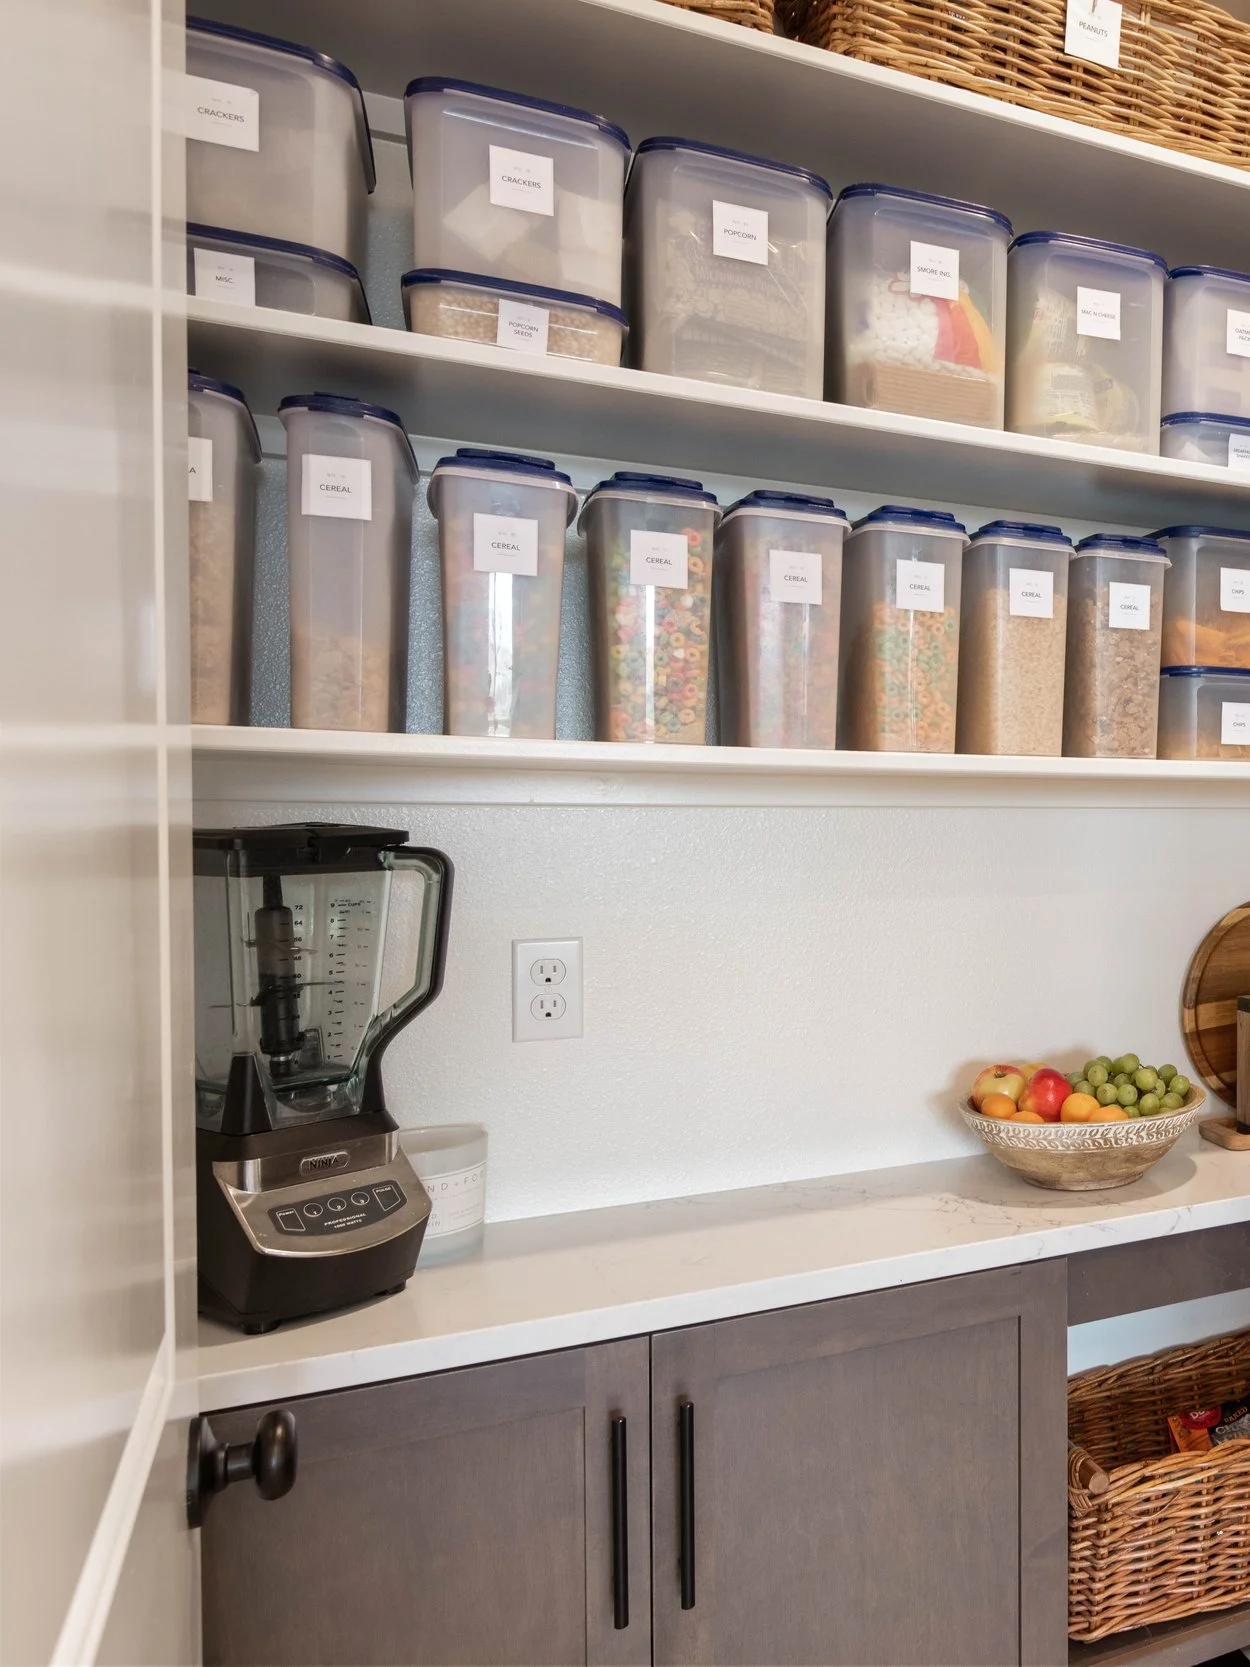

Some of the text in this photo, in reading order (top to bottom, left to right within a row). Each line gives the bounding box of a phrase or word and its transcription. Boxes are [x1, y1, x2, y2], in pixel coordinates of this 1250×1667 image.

[1079, 21, 1109, 37] PEANUTS
[197, 106, 245, 123] CRACKERS
[501, 175, 542, 189] CRACKERS
[723, 228, 757, 241] POPCORN
[916, 266, 938, 276] SMORE
[508, 321, 539, 333] POPCORN
[513, 329, 533, 339] SEEDS
[319, 484, 352, 494] CEREAL
[491, 541, 521, 552] CEREAL
[645, 556, 673, 566] CEREAL
[783, 575, 808, 583] CEREAL
[909, 583, 931, 592] CEREAL
[1021, 591, 1042, 599] CEREAL
[1119, 604, 1140, 612] CEREAL
[308, 1156, 339, 1170] NINJA
[375, 1186, 392, 1194] PULSE
[324, 1213, 367, 1227] PROFESSIONAL
